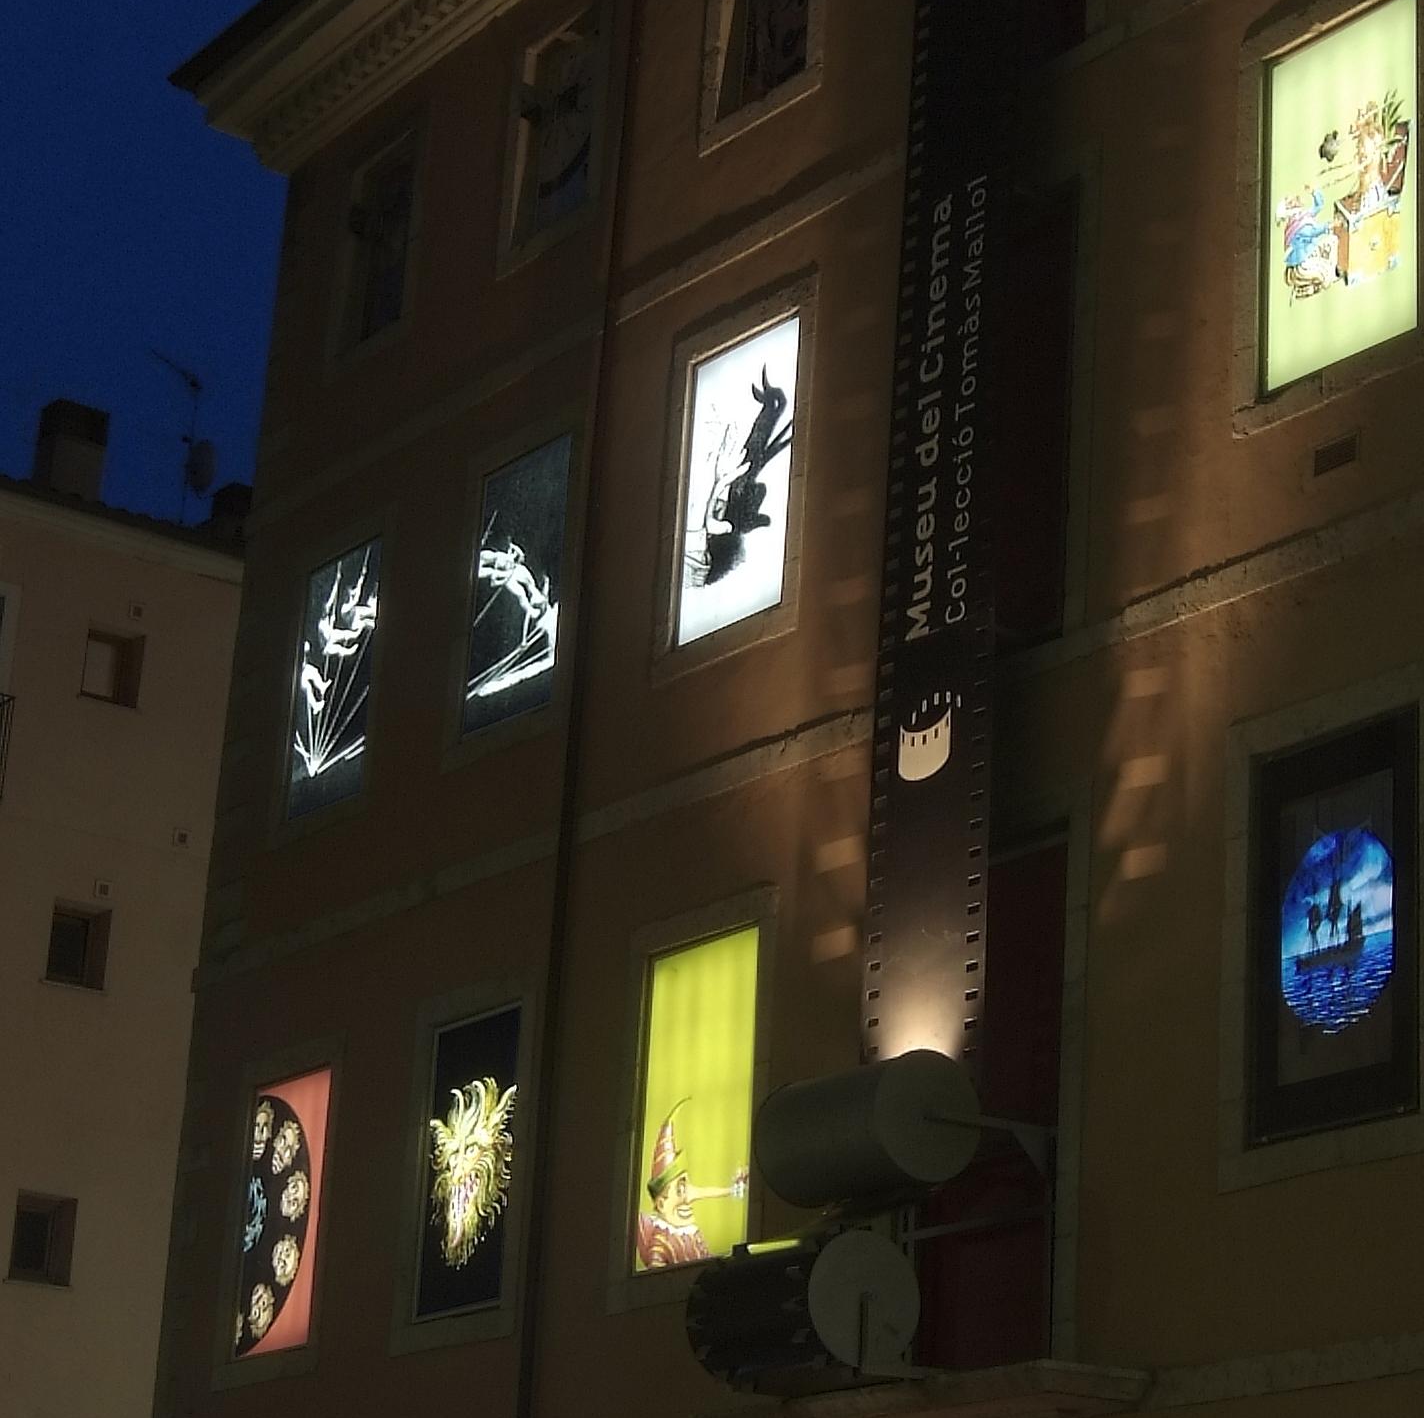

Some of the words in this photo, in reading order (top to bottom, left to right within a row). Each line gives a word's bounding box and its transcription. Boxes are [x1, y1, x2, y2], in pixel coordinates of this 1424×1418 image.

[919, 193, 953, 382] Cinema
[961, 174, 988, 292] Mallol
[954, 293, 983, 422] Tomàs
[914, 390, 942, 468] del
[905, 476, 938, 642] Museu
